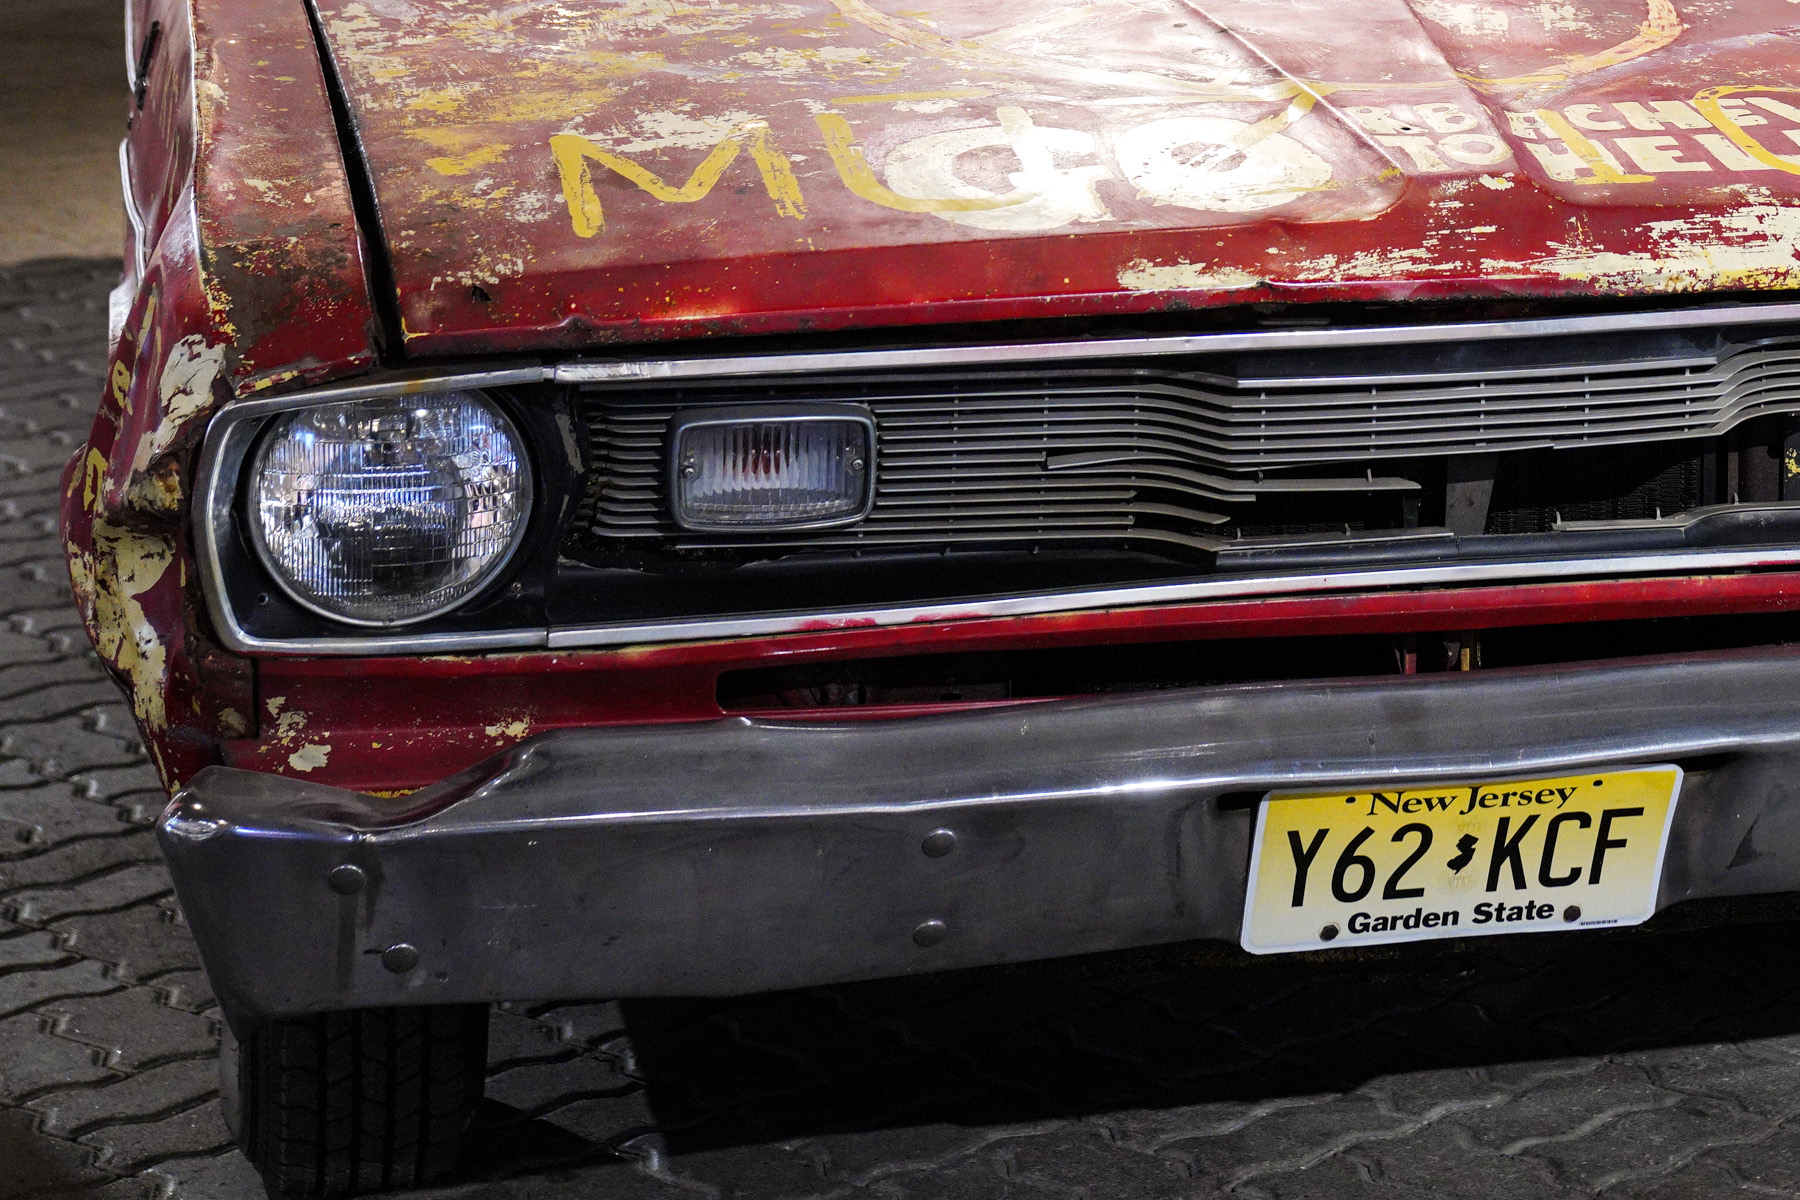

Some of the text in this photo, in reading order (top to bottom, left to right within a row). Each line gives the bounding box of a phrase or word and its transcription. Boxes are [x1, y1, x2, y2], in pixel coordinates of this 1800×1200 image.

[1366, 784, 1578, 817] New Jersey
[1286, 807, 1645, 908] Y62 KCF
[1347, 900, 1555, 935] Garden State
